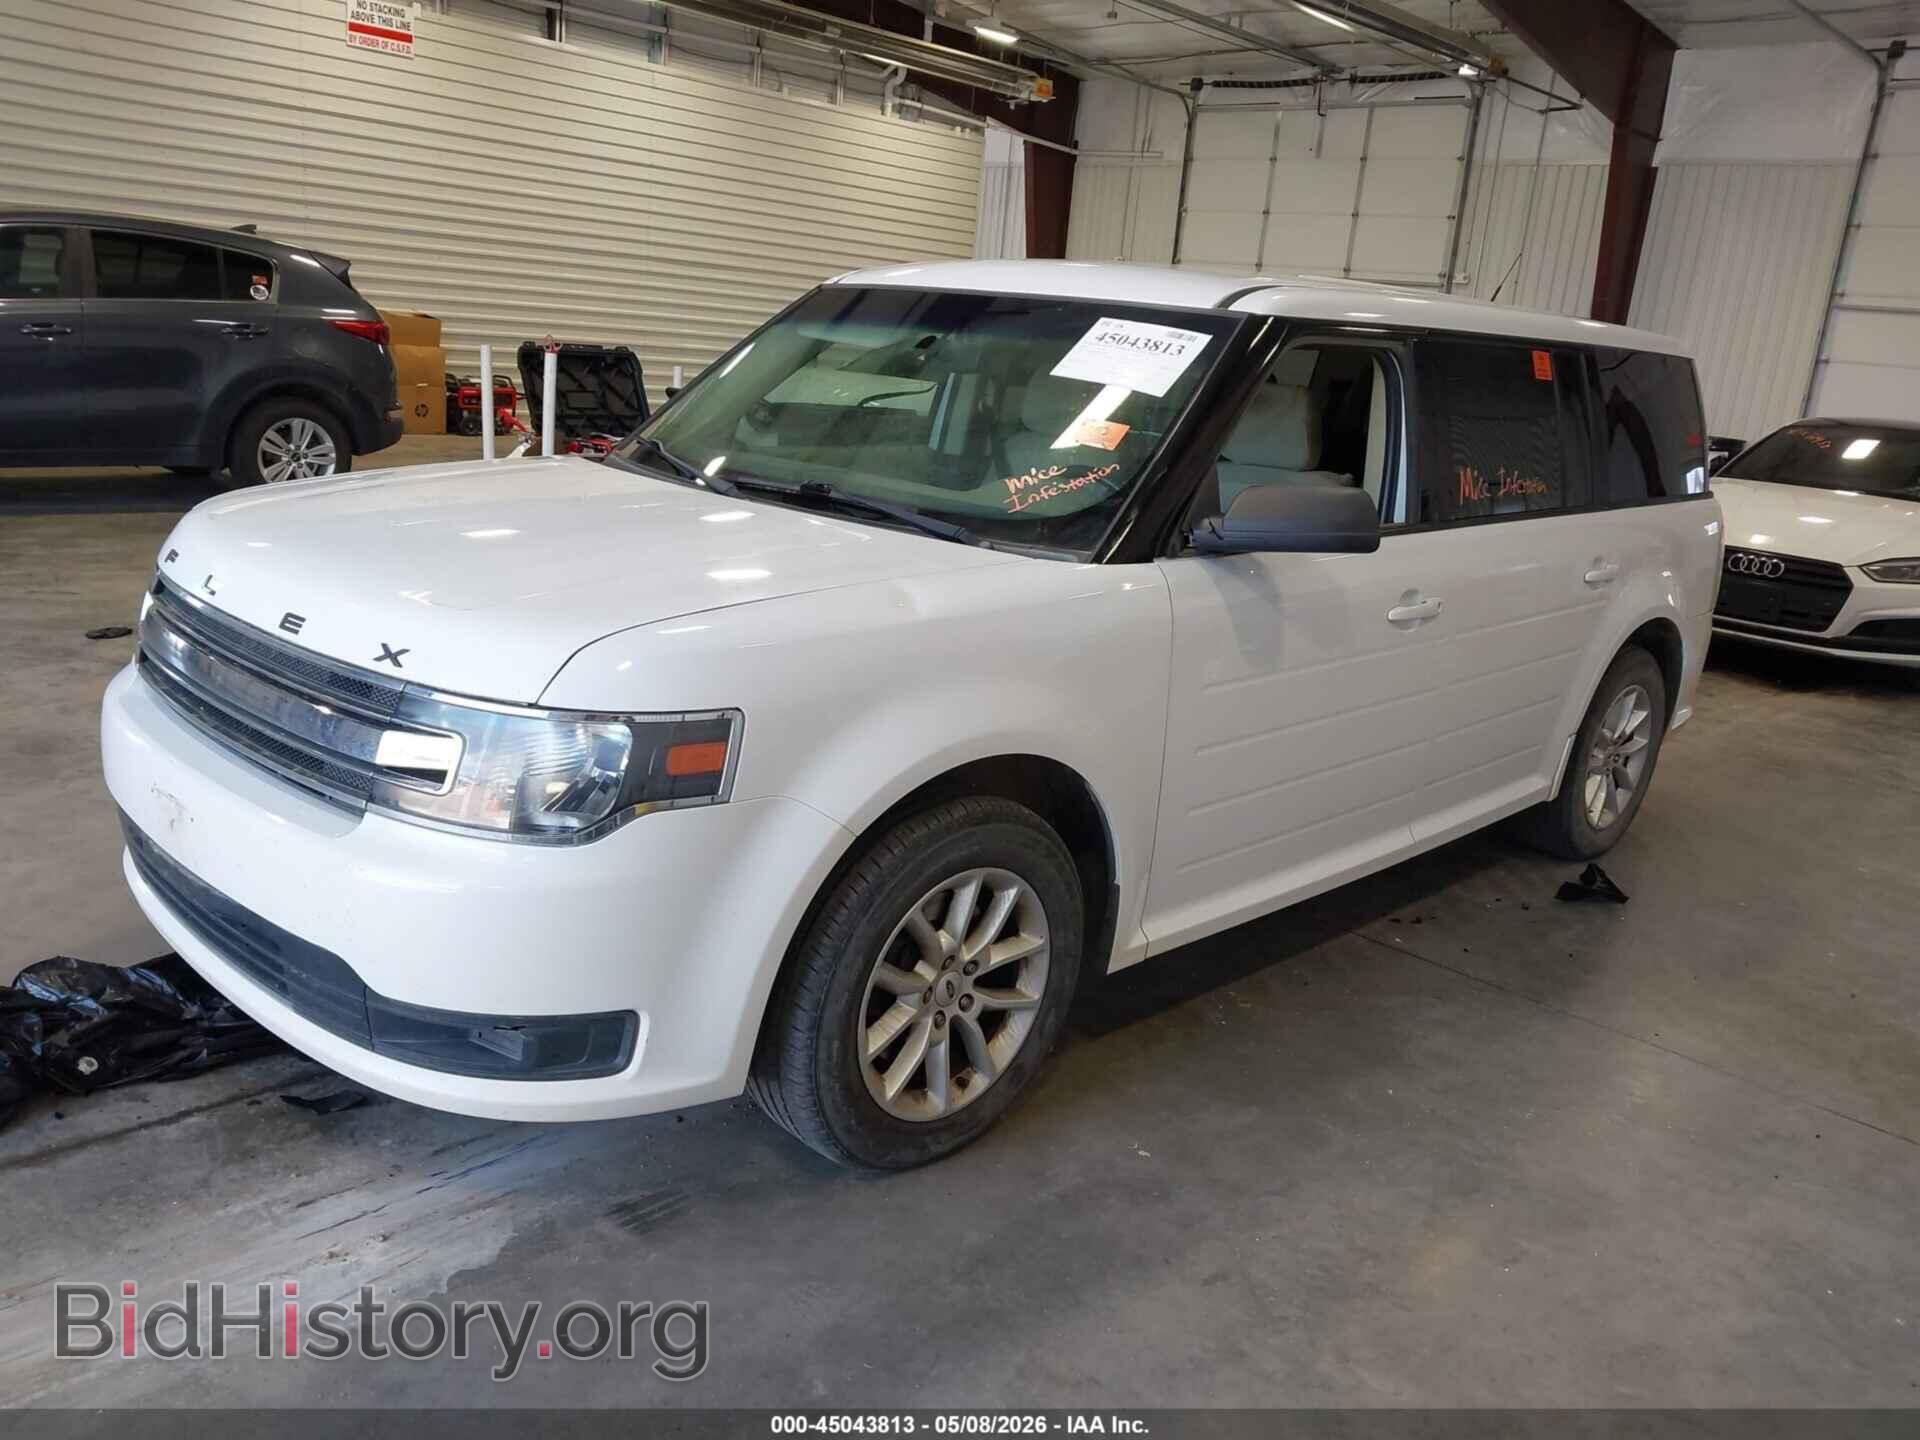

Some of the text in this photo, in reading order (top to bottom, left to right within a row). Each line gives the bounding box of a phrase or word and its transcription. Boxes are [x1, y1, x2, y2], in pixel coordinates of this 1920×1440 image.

[357, 0, 405, 18] NO STACKING
[351, 10, 411, 31] ABOVE THIS LINE
[349, 33, 358, 43] BY
[360, 35, 379, 47] ORDER
[1095, 331, 1186, 357] 45043813
[164, 548, 411, 669] FLEX
